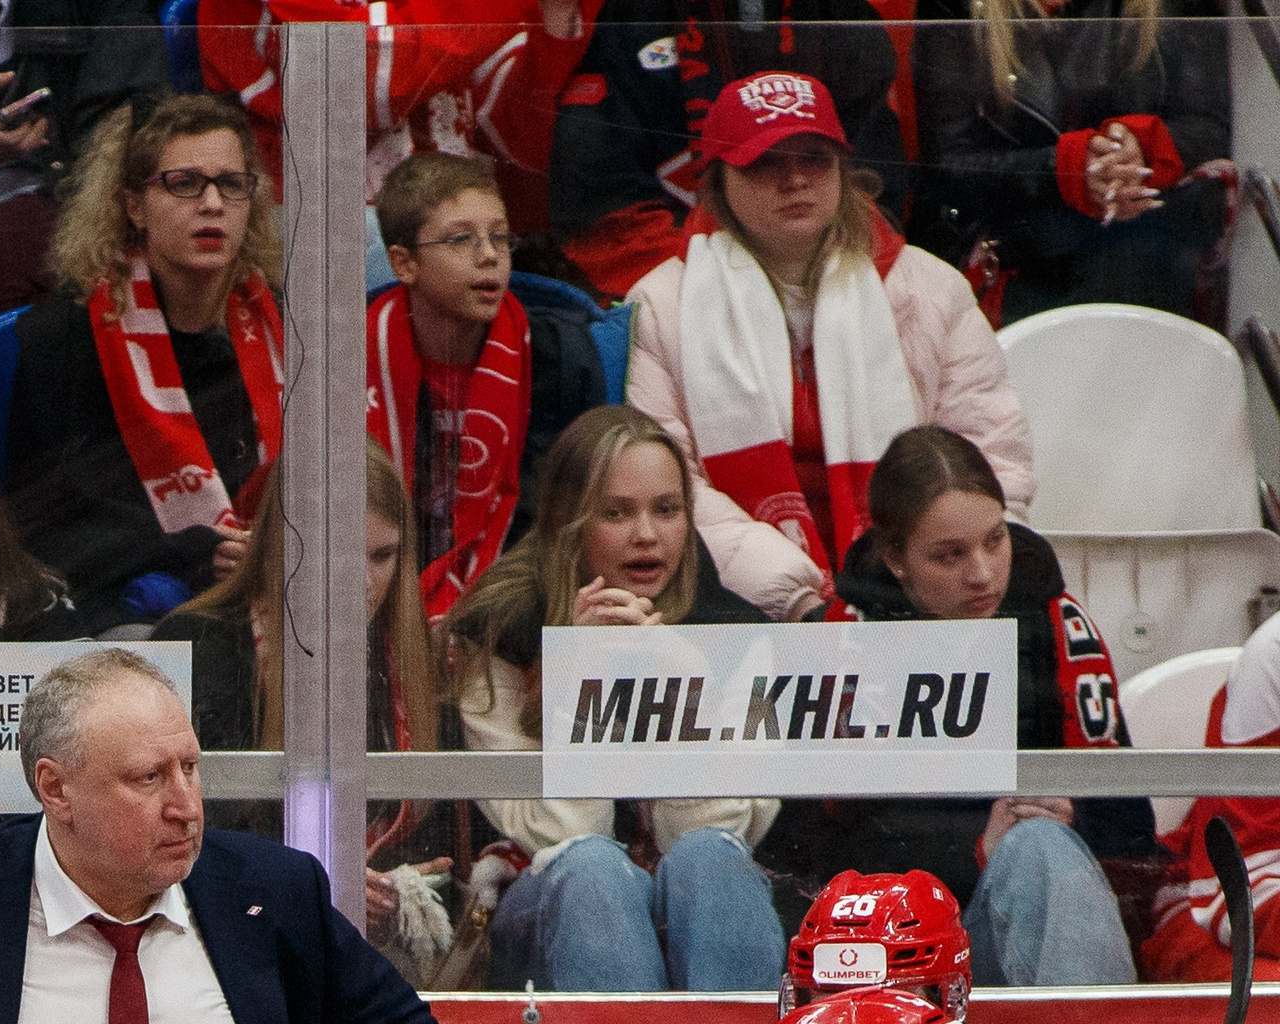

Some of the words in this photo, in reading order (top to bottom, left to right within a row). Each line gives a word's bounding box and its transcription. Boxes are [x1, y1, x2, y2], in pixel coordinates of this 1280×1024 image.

[569, 672, 990, 744] MHL.KHL.RU
[830, 895, 878, 918] 26
[818, 970, 881, 980] OLIMPBET
